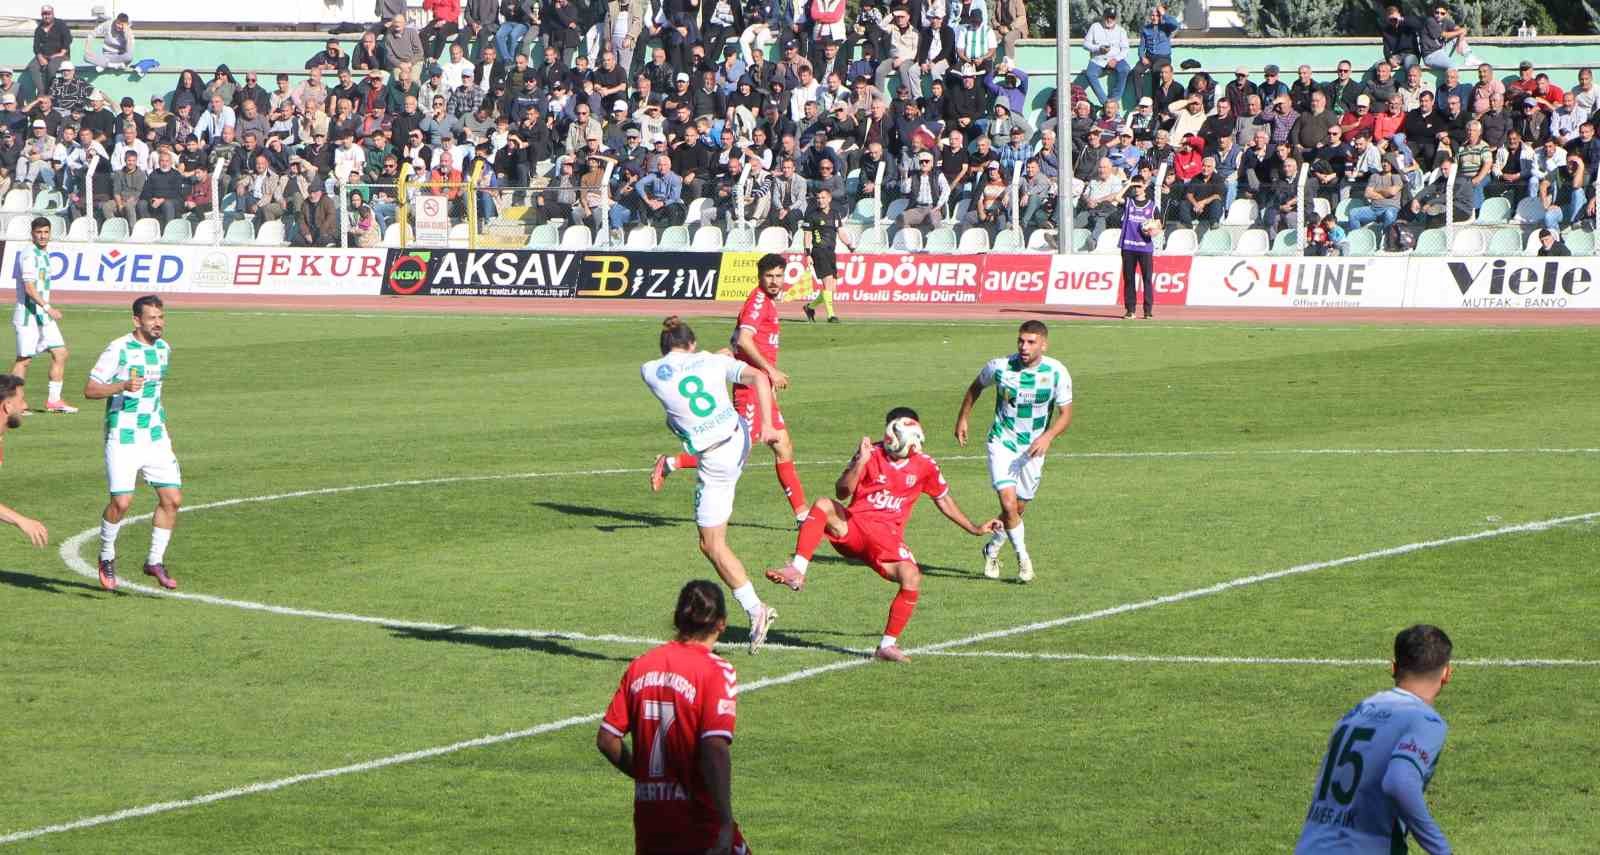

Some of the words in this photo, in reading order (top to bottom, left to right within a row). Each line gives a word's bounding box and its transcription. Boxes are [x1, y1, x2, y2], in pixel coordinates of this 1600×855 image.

[268, 255, 382, 277] EKUR
[390, 270, 426, 281] AKSAV
[432, 252, 575, 286] AKSAV
[872, 255, 977, 286] DÖNER
[1447, 259, 1592, 296] Viele
[984, 271, 1045, 292] aves
[1054, 270, 1114, 291] aves
[853, 289, 890, 302] Usulü
[931, 290, 976, 303] Dürüm
[1462, 297, 1512, 308] MUTFAK
[1524, 298, 1568, 308] BANYO
[678, 375, 717, 418] 8
[641, 699, 676, 778] 7
[1317, 724, 1377, 806] 15
